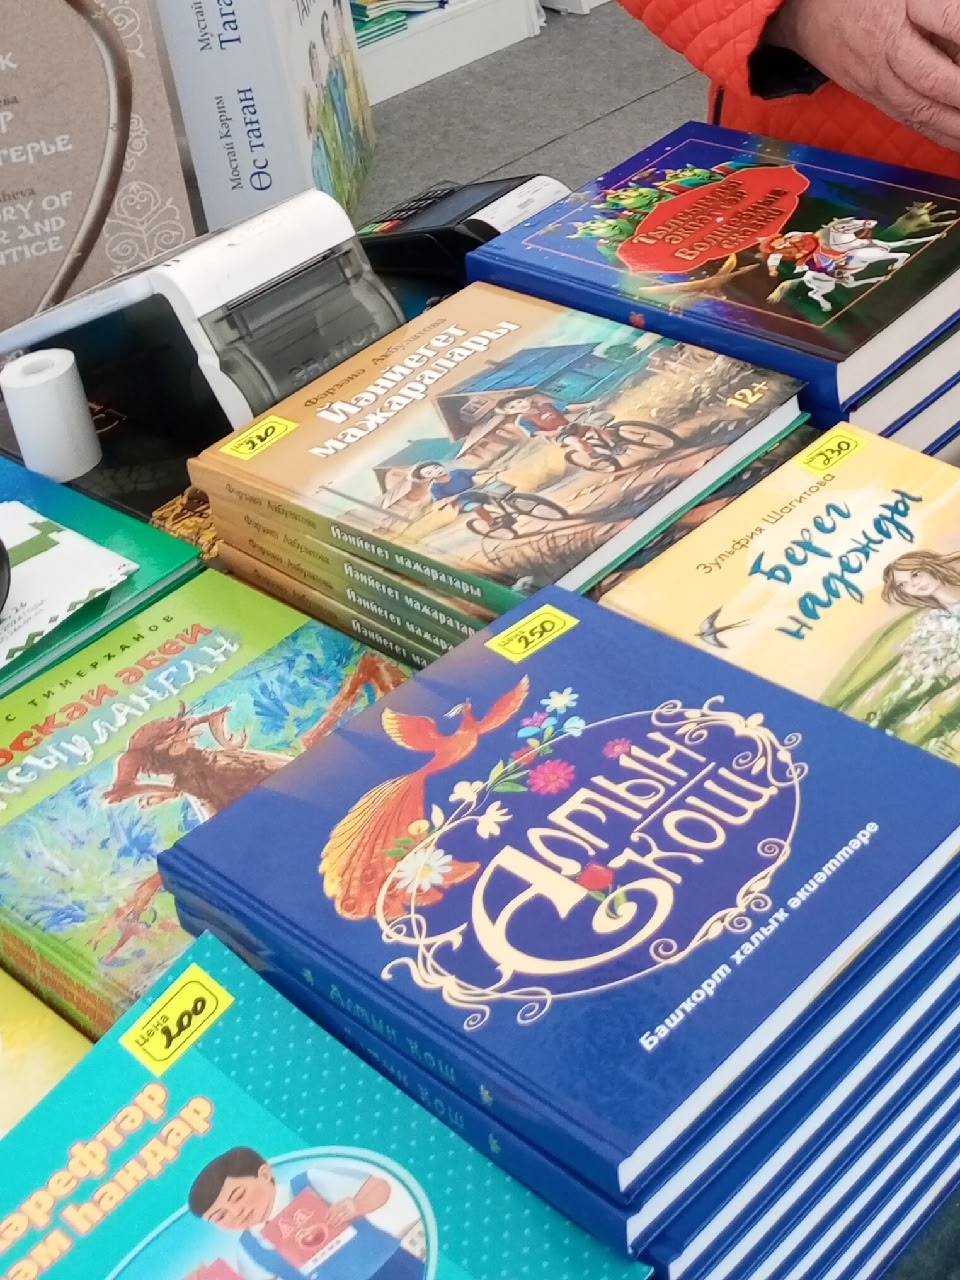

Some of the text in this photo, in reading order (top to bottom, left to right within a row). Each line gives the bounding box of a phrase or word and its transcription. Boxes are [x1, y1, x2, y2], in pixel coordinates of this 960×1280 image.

[191, 0, 212, 51] Мустай
[237, 88, 265, 152] таған
[220, 141, 243, 191] Мостай
[42, 190, 73, 211] OF
[17, 216, 65, 239] AND
[308, 320, 521, 459] мажаралары
[316, 323, 468, 424] Йәнйегет
[726, 379, 769, 410] 12+
[817, 440, 850, 466] 230
[696, 473, 836, 574] Зульфия Шагитова
[748, 501, 852, 585] Берег
[775, 489, 923, 640] надежды
[517, 620, 555, 649] 250
[161, 996, 206, 1049] 200
